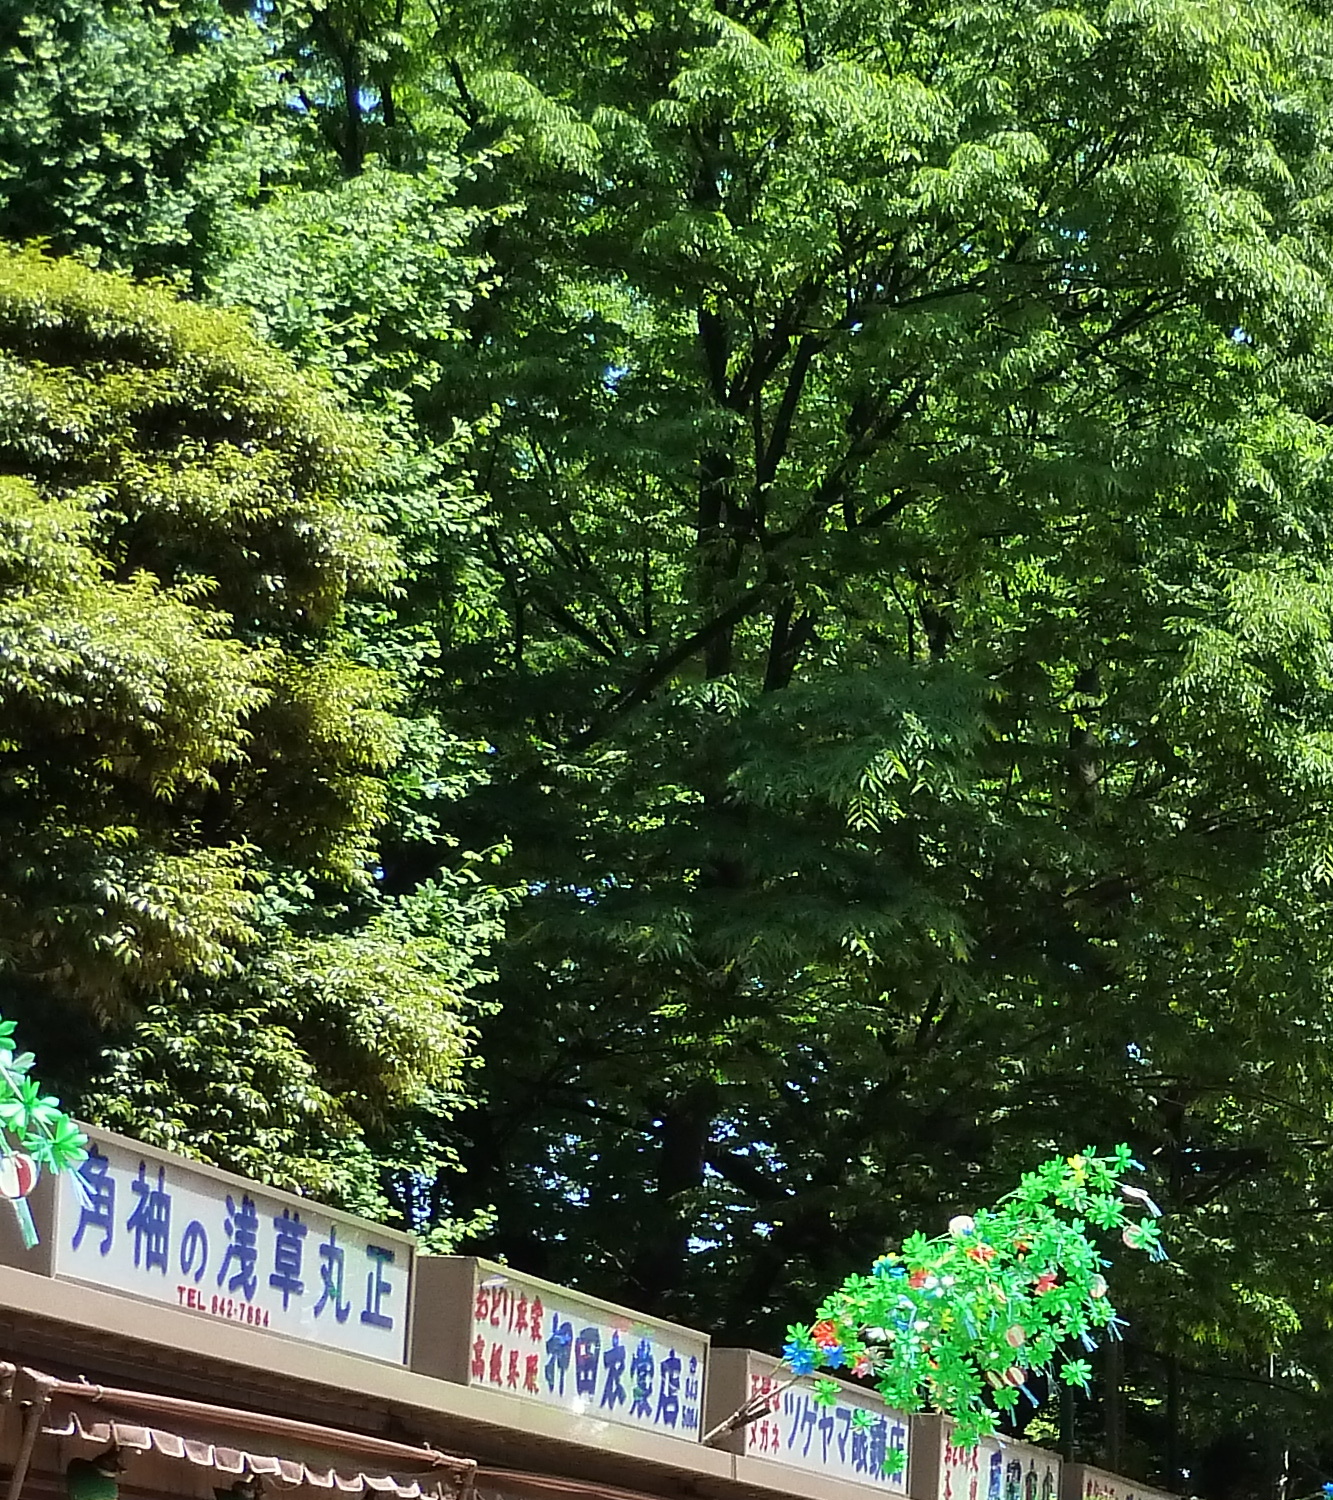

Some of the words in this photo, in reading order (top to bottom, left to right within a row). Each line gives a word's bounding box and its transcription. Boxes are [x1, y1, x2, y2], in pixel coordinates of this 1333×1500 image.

[72, 1143, 395, 1331] 角袖の浅草丸正
[177, 1285, 206, 1311] TEL
[749, 1419, 781, 1455] メガネ
